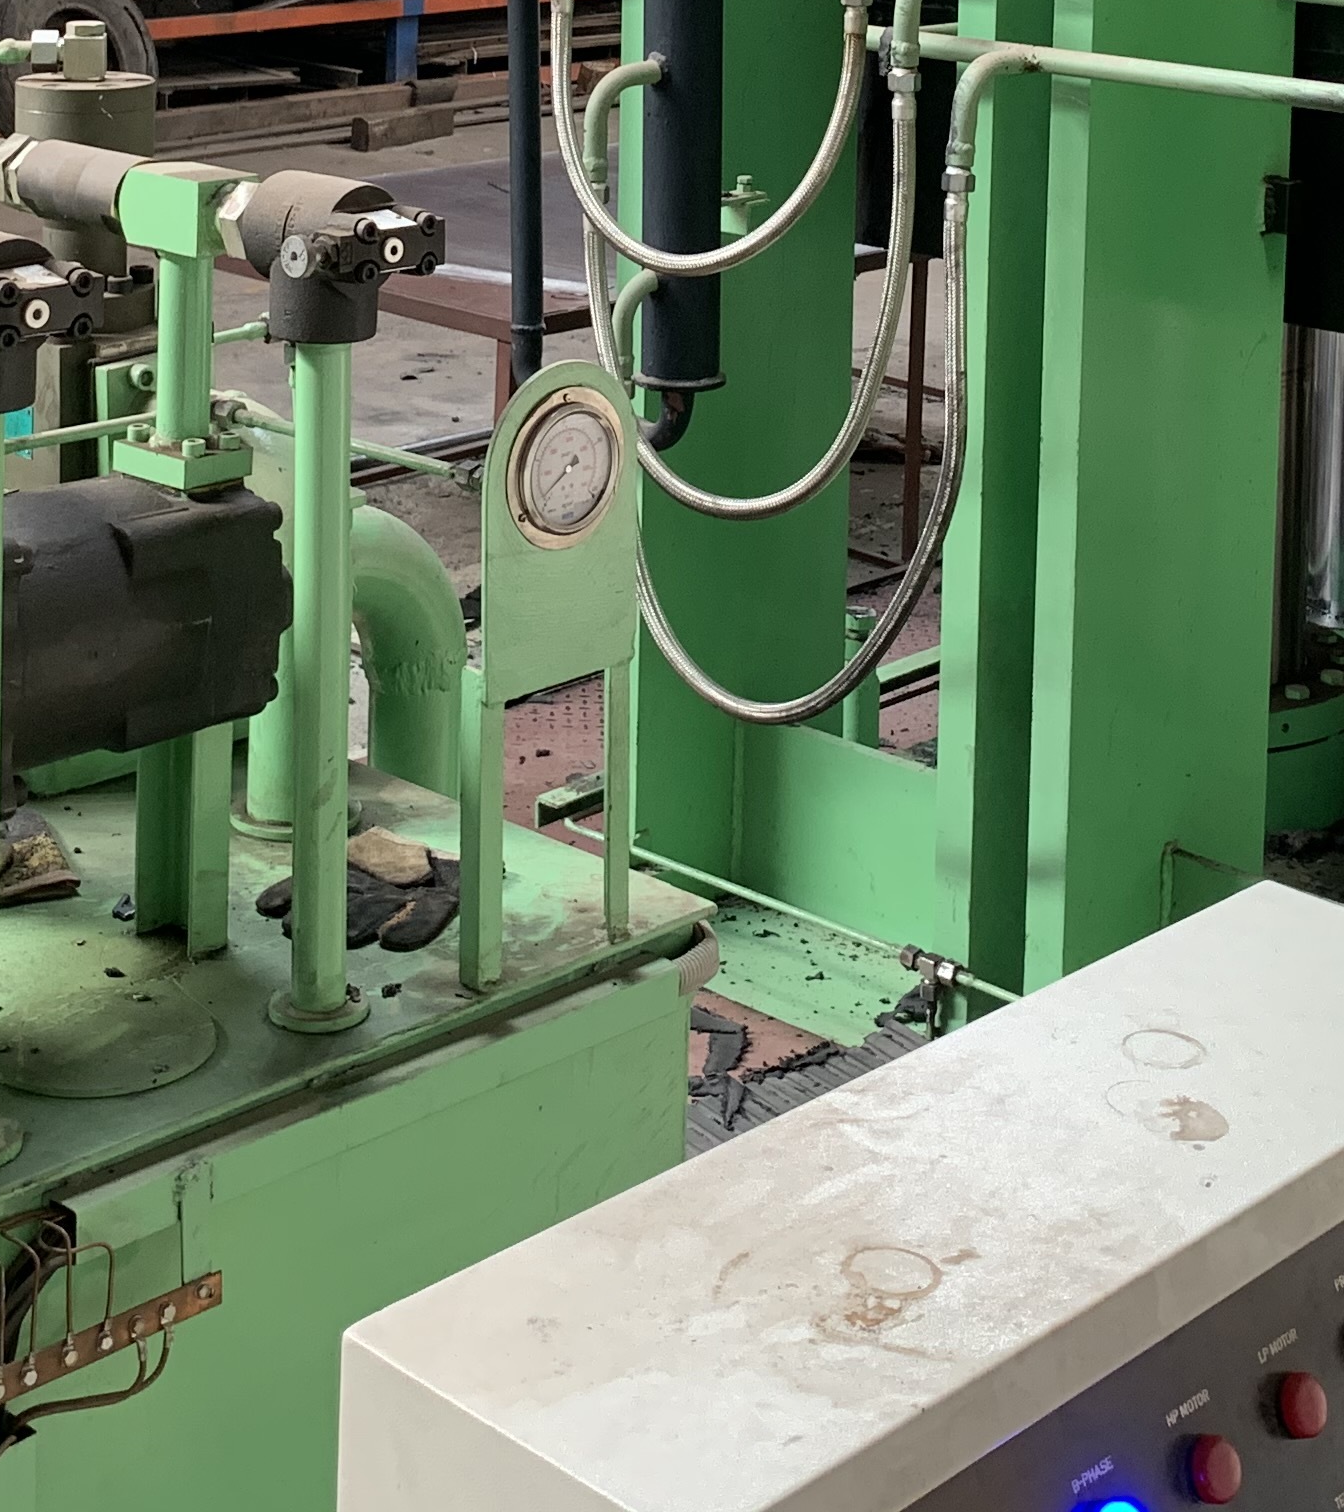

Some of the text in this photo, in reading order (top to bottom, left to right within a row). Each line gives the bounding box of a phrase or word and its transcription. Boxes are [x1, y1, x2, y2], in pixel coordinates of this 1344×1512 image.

[1257, 1327, 1299, 1365] LP MOTOR
[1165, 1388, 1210, 1428] HP MOTOR
[1070, 1454, 1114, 1495] B-PHASE
